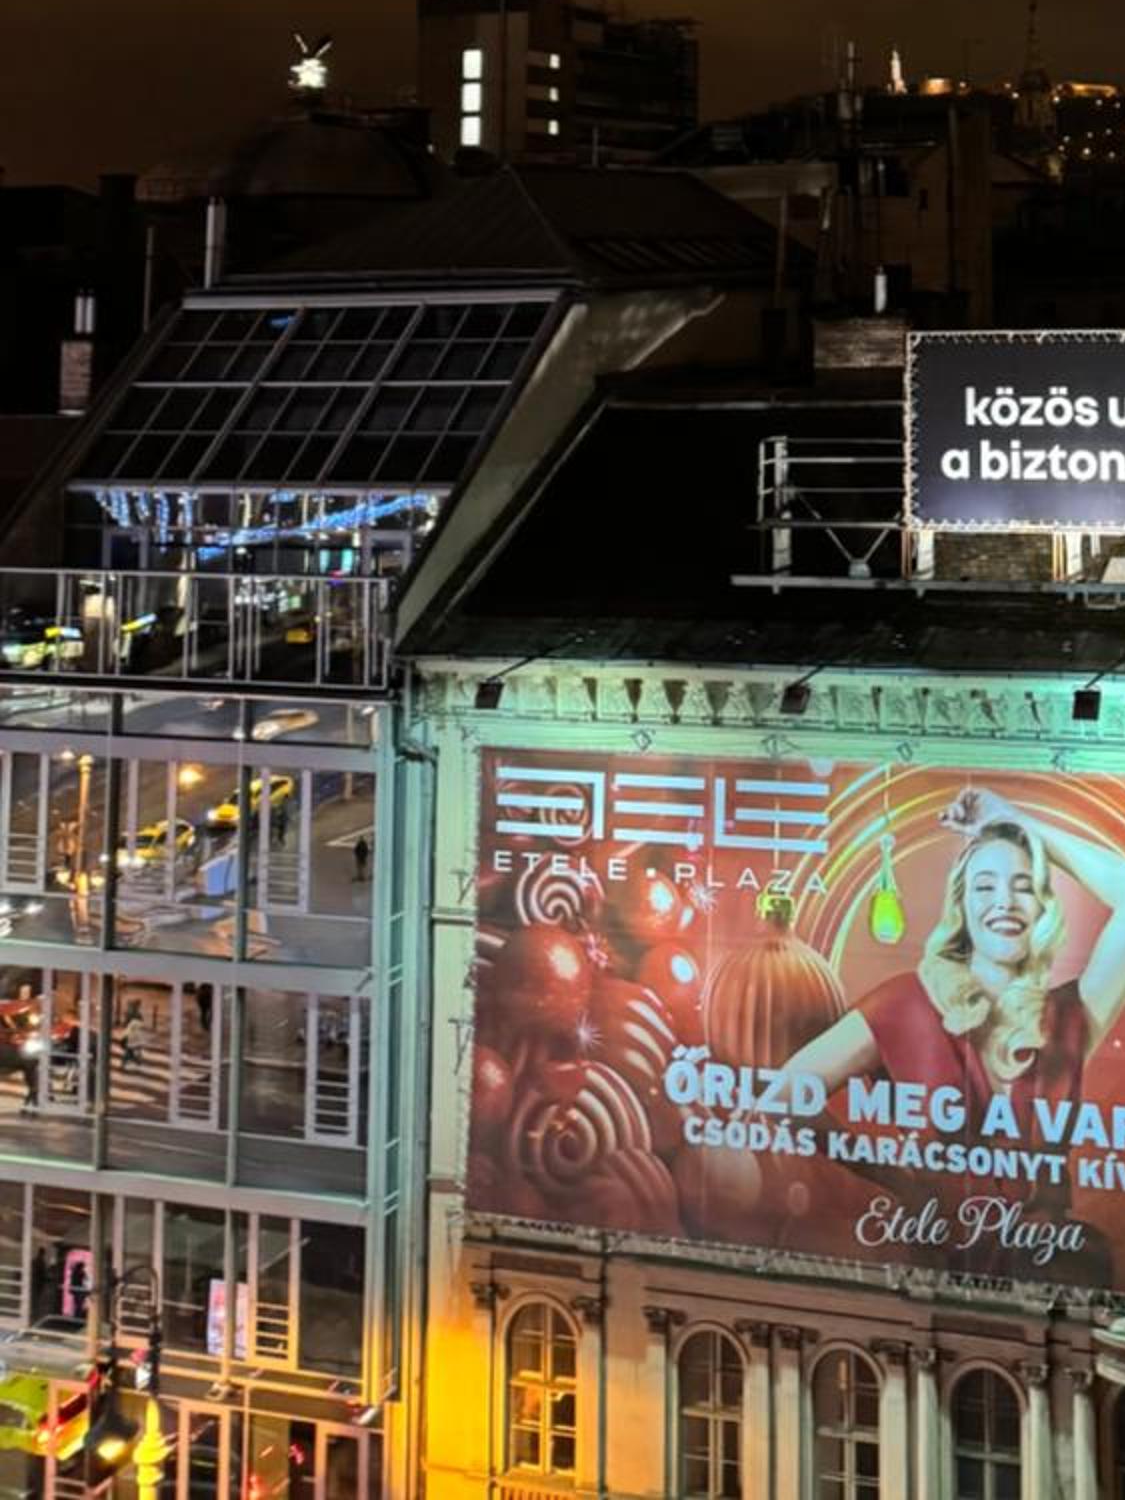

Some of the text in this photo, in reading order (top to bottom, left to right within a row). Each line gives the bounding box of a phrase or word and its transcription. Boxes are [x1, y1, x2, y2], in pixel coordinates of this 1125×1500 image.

[965, 387, 1099, 428] közös
[941, 446, 970, 480] a
[493, 850, 829, 895] ETELE PLAZA
[663, 1045, 827, 1117] ŐRIZD
[848, 1078, 966, 1134] MEG
[983, 1094, 1027, 1137] A
[828, 1132, 1065, 1185] KARÁCSONYT
[854, 1194, 1085, 1267] Etele Plaza
